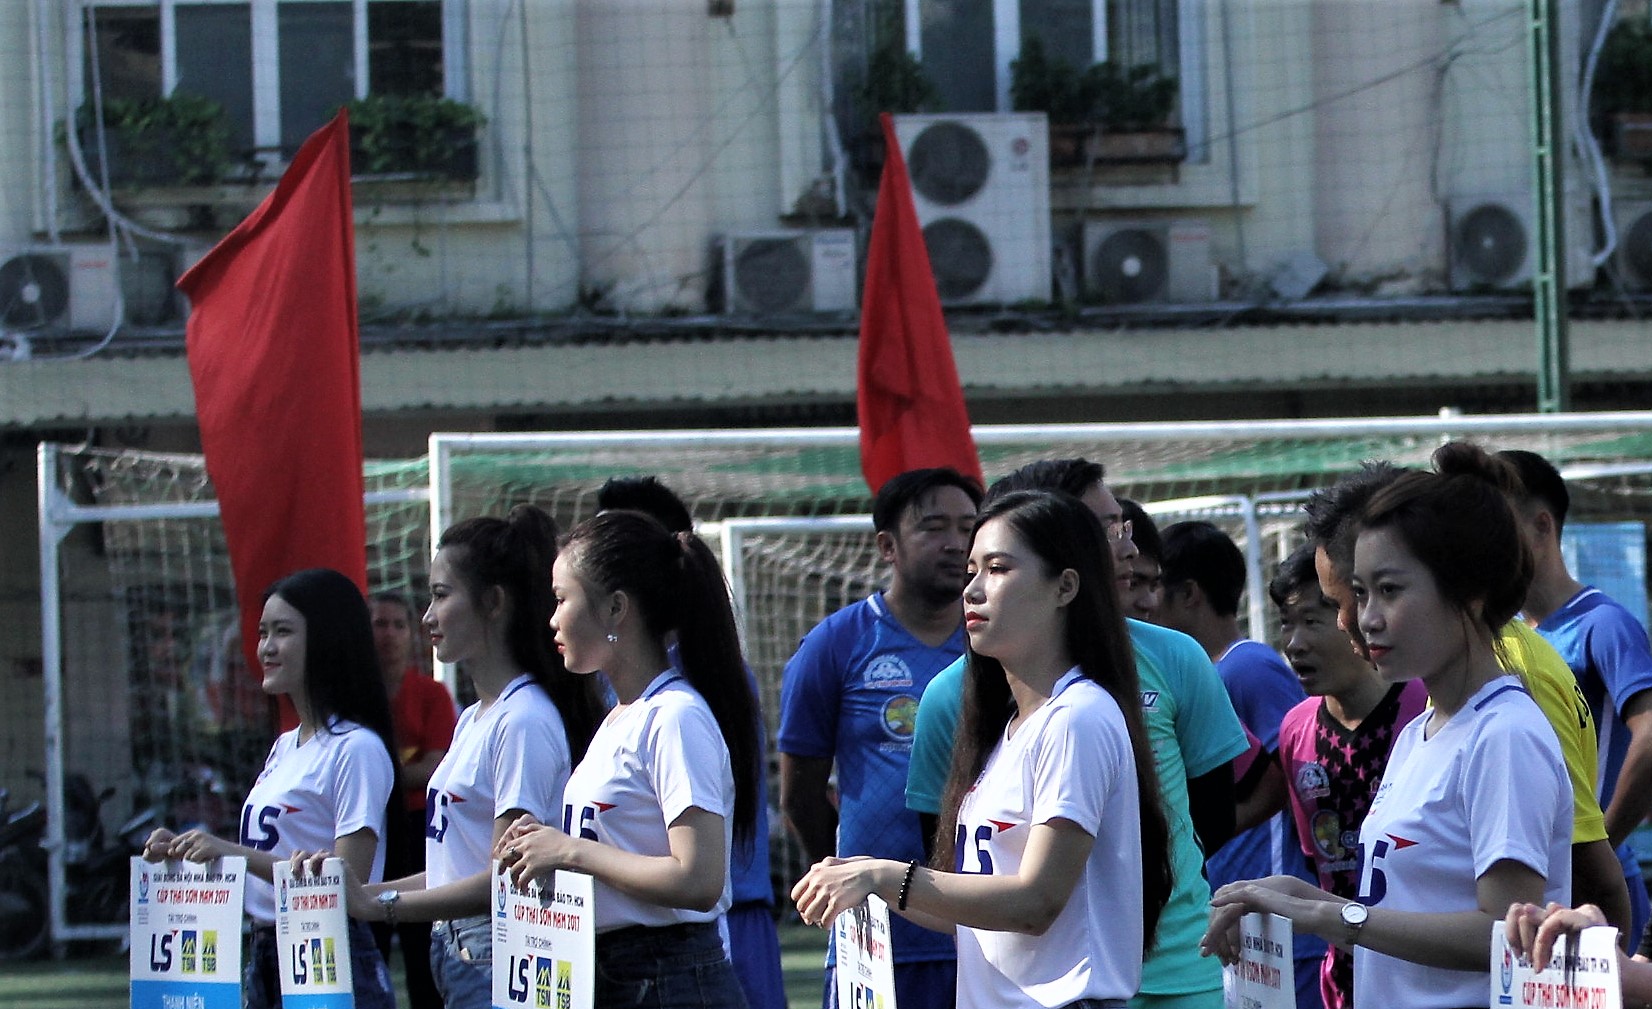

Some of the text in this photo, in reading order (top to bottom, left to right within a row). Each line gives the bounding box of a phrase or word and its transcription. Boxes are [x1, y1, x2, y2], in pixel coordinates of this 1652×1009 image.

[241, 804, 281, 850] LS
[567, 914, 580, 932] 2017
[150, 934, 173, 972] LS
[292, 944, 307, 985] LS
[509, 955, 529, 1003] LS
[536, 988, 551, 1007] TSN
